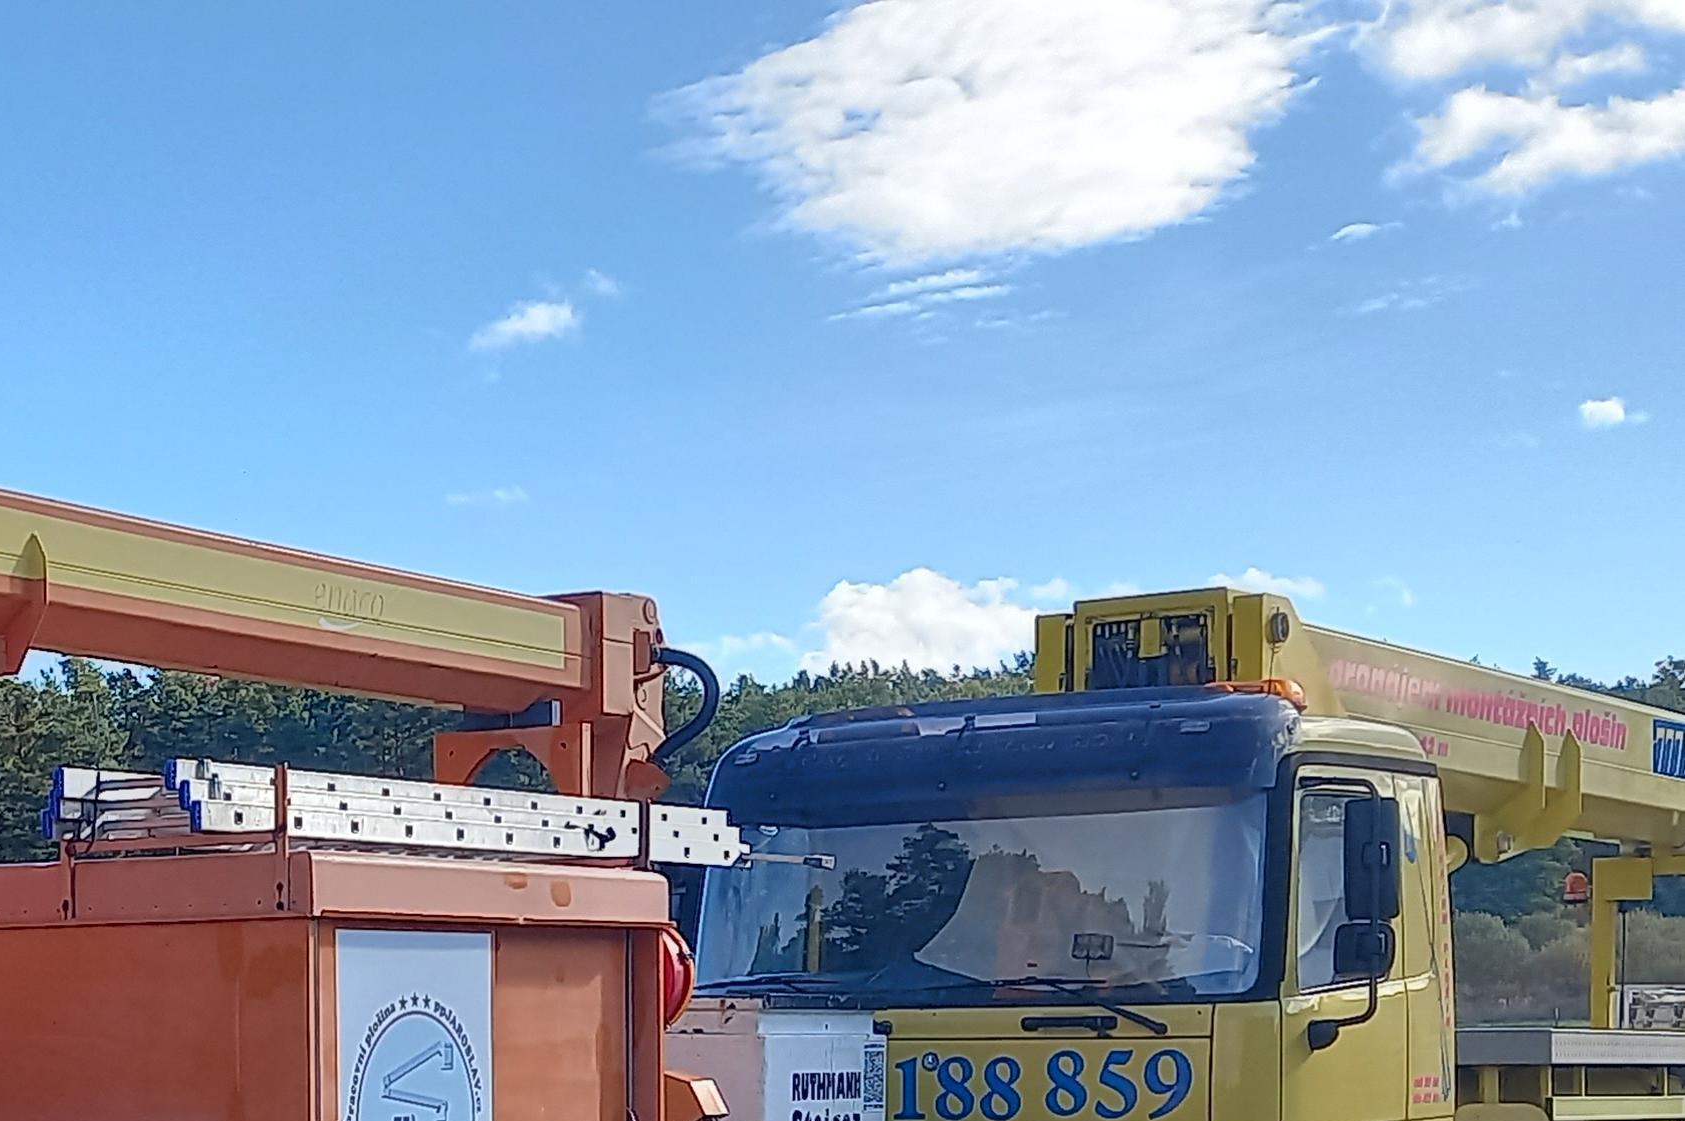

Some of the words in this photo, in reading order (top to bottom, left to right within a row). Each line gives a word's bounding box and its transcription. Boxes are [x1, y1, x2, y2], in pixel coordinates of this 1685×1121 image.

[1571, 707, 1628, 751] plošin
[364, 1002, 397, 1049] plošina
[791, 1071, 862, 1102] RUTHMANN
[893, 1055, 1023, 1121] 188
[1044, 1048, 1193, 1121] 859
